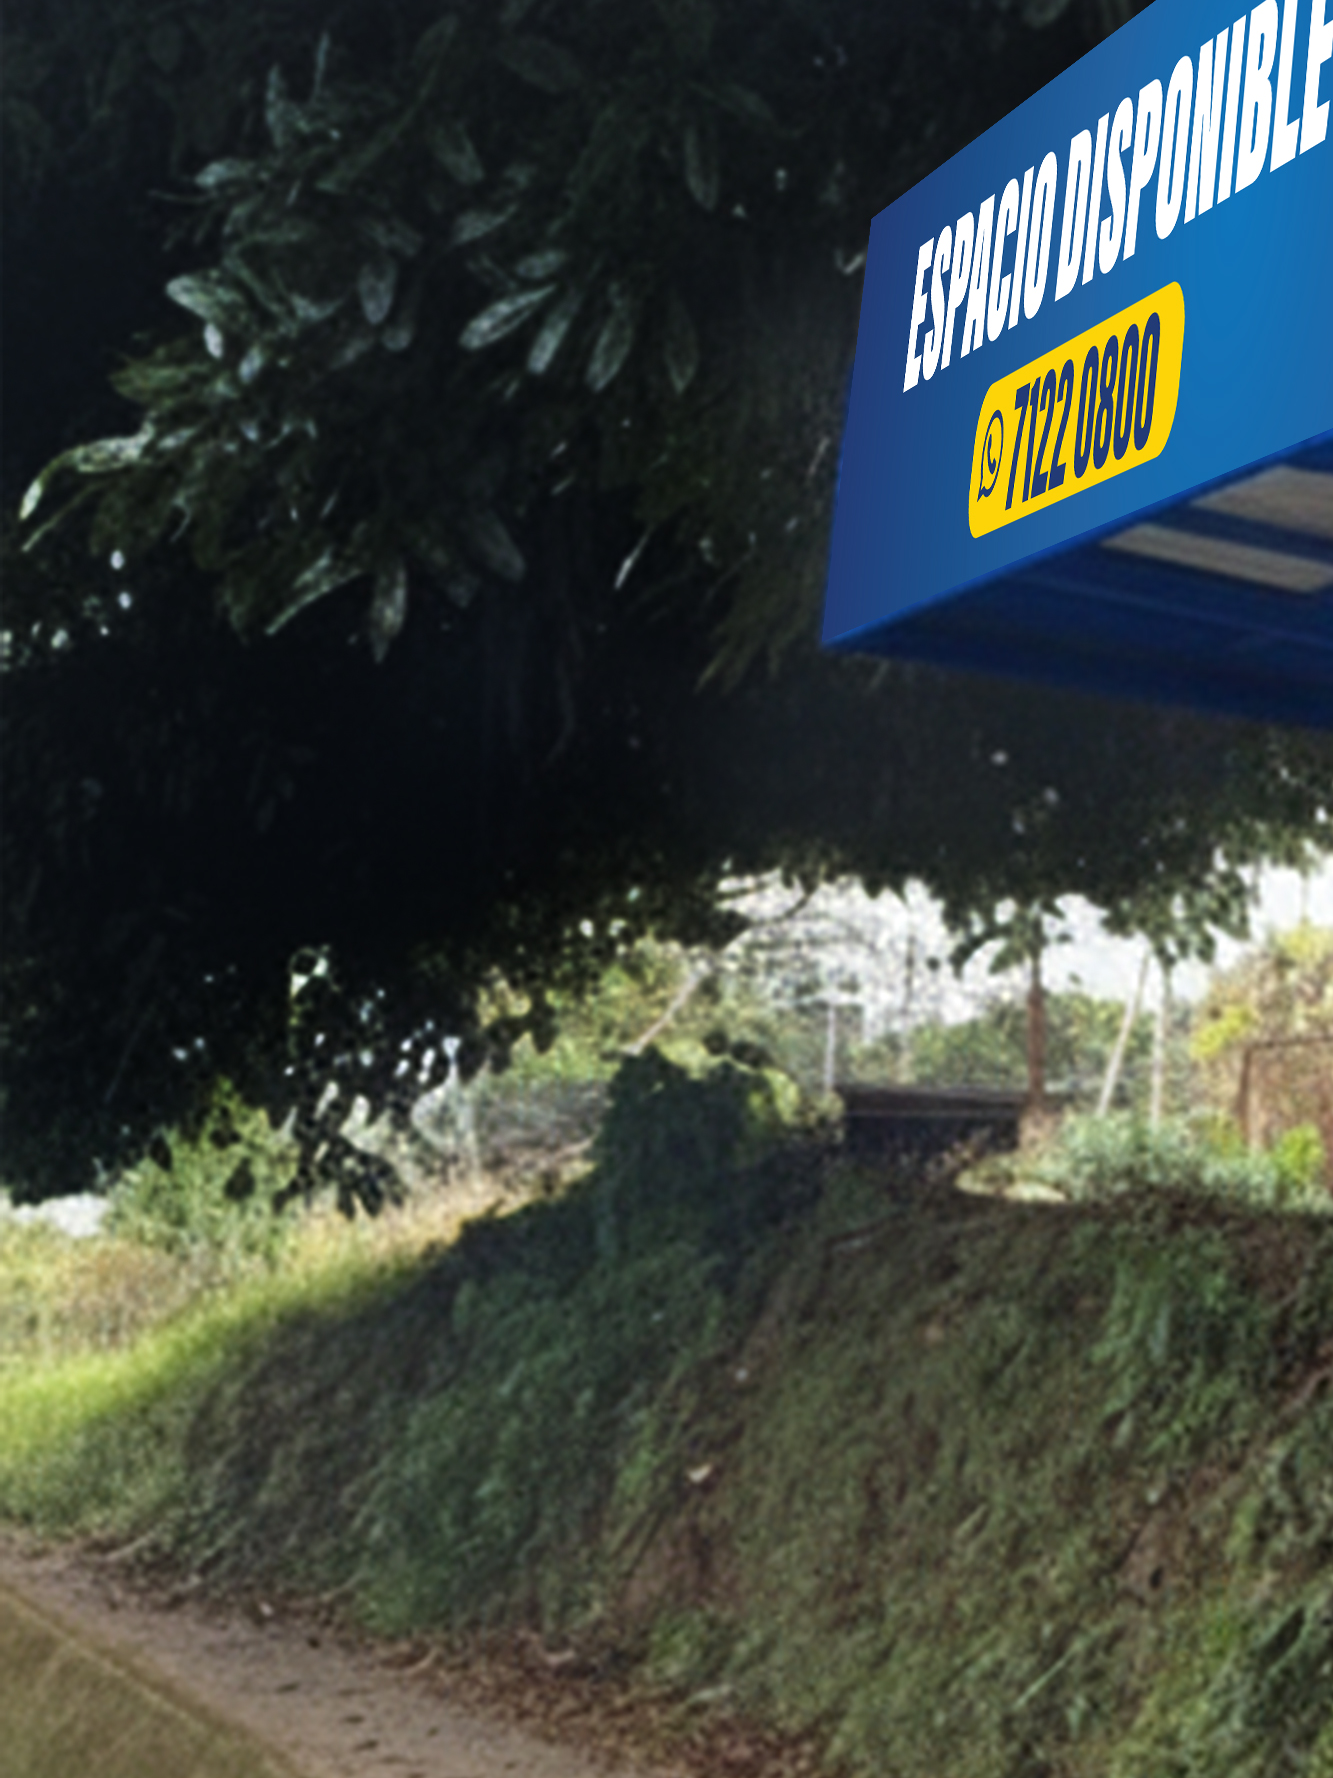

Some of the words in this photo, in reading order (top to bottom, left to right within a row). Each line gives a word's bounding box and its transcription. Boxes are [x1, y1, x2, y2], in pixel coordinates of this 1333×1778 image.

[903, 151, 1057, 393] ESPACIO
[1005, 359, 1074, 510] 7122
[1074, 312, 1160, 478] 0800
